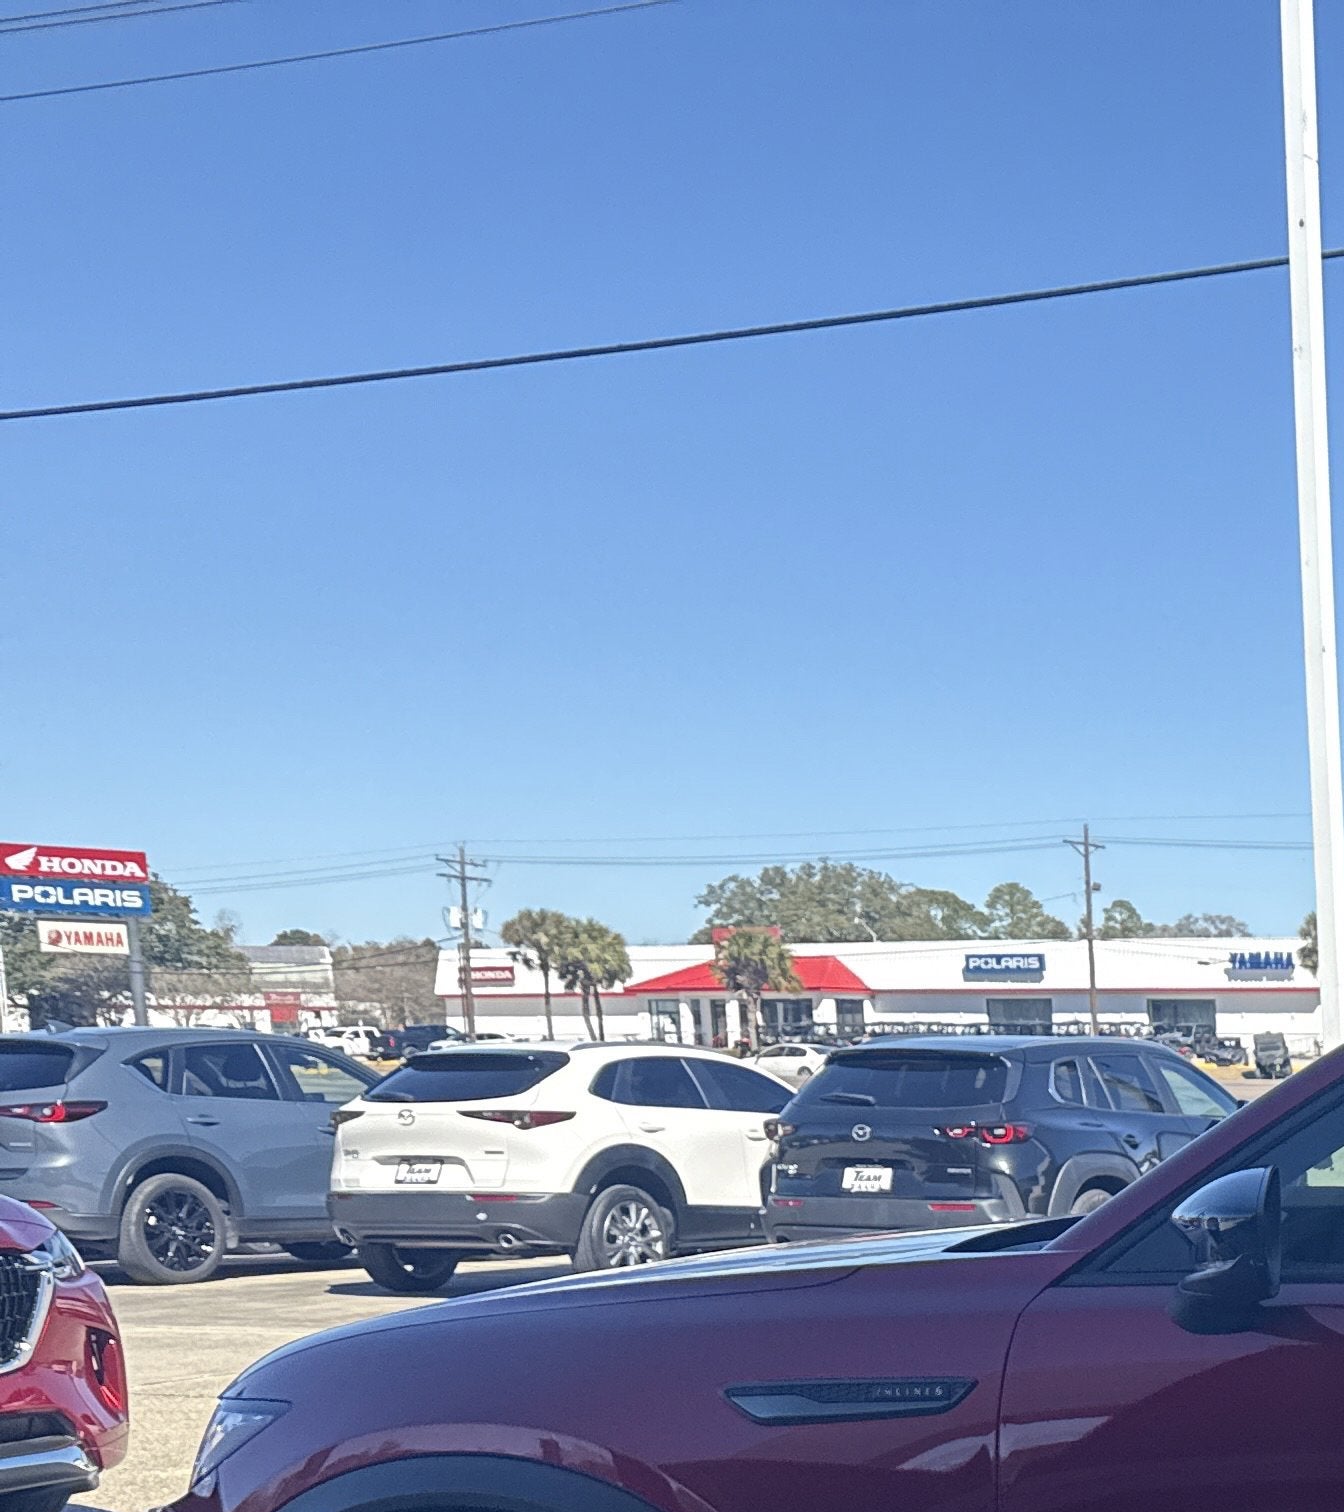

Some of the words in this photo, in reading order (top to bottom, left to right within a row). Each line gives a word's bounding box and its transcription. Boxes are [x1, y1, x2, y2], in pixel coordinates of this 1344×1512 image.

[38, 856, 146, 878] HONDA
[11, 884, 143, 908] POLARIS
[63, 930, 124, 947] YAMAHA
[968, 957, 1041, 969] POLARIS
[1229, 952, 1295, 969] YAMAHA
